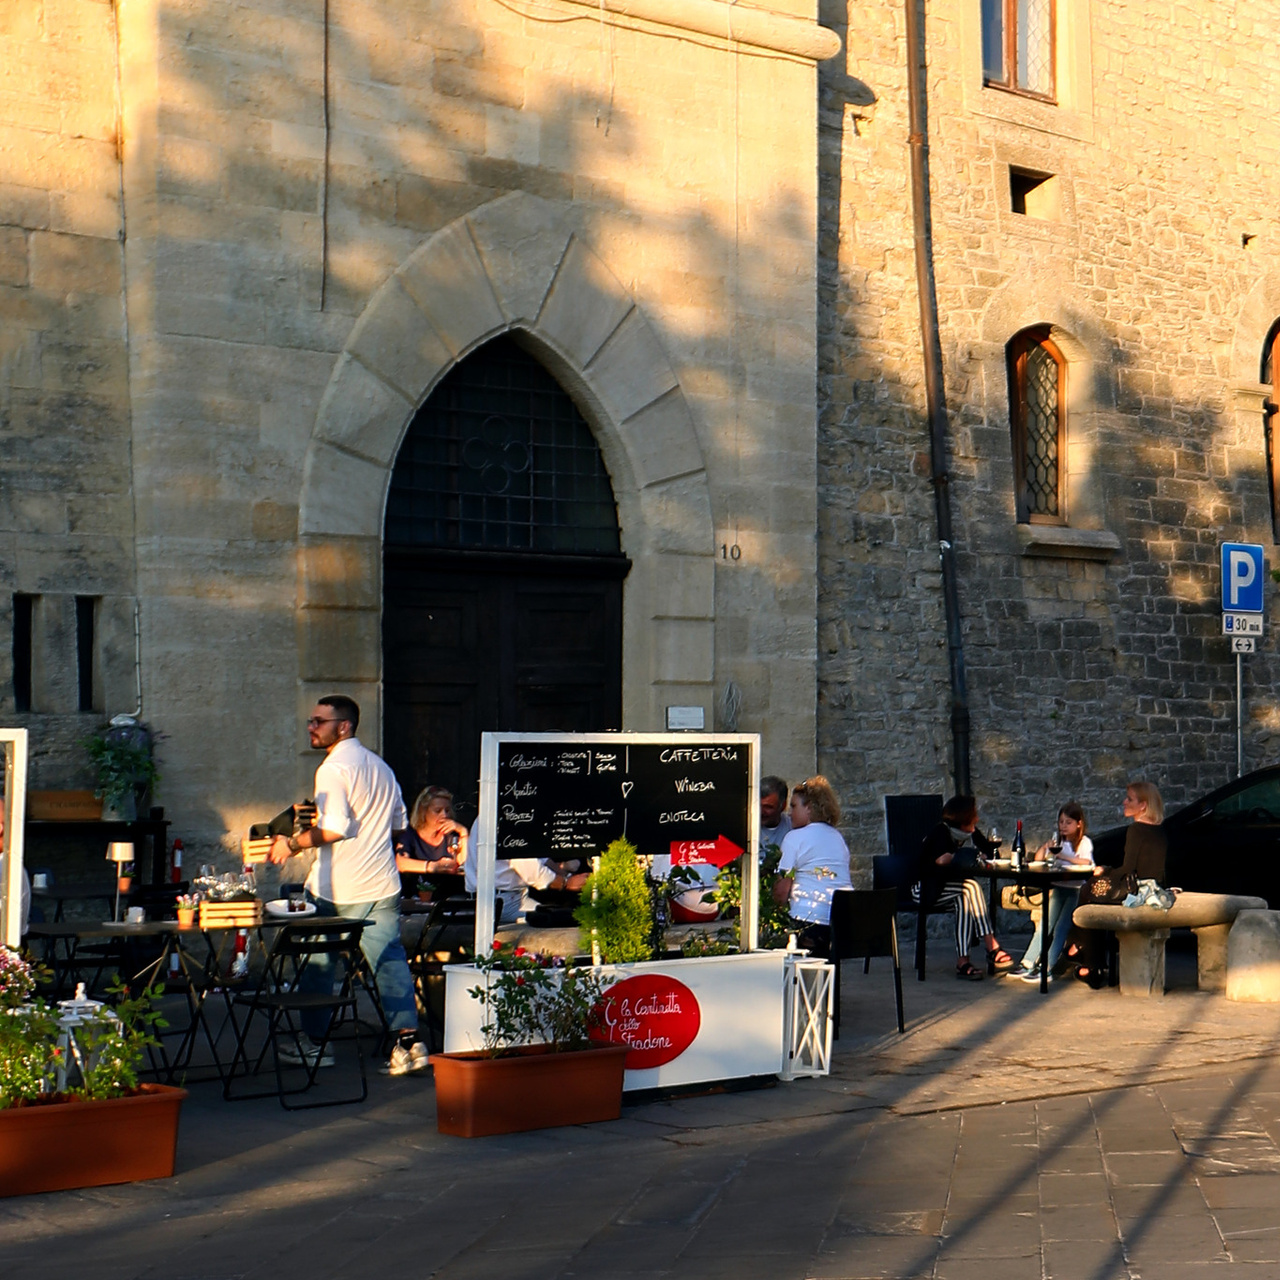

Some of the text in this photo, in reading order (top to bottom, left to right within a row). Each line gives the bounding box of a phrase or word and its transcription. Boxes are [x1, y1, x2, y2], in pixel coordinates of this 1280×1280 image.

[721, 543, 741, 560] 10
[1230, 550, 1256, 605] P
[1235, 618, 1246, 631] 30
